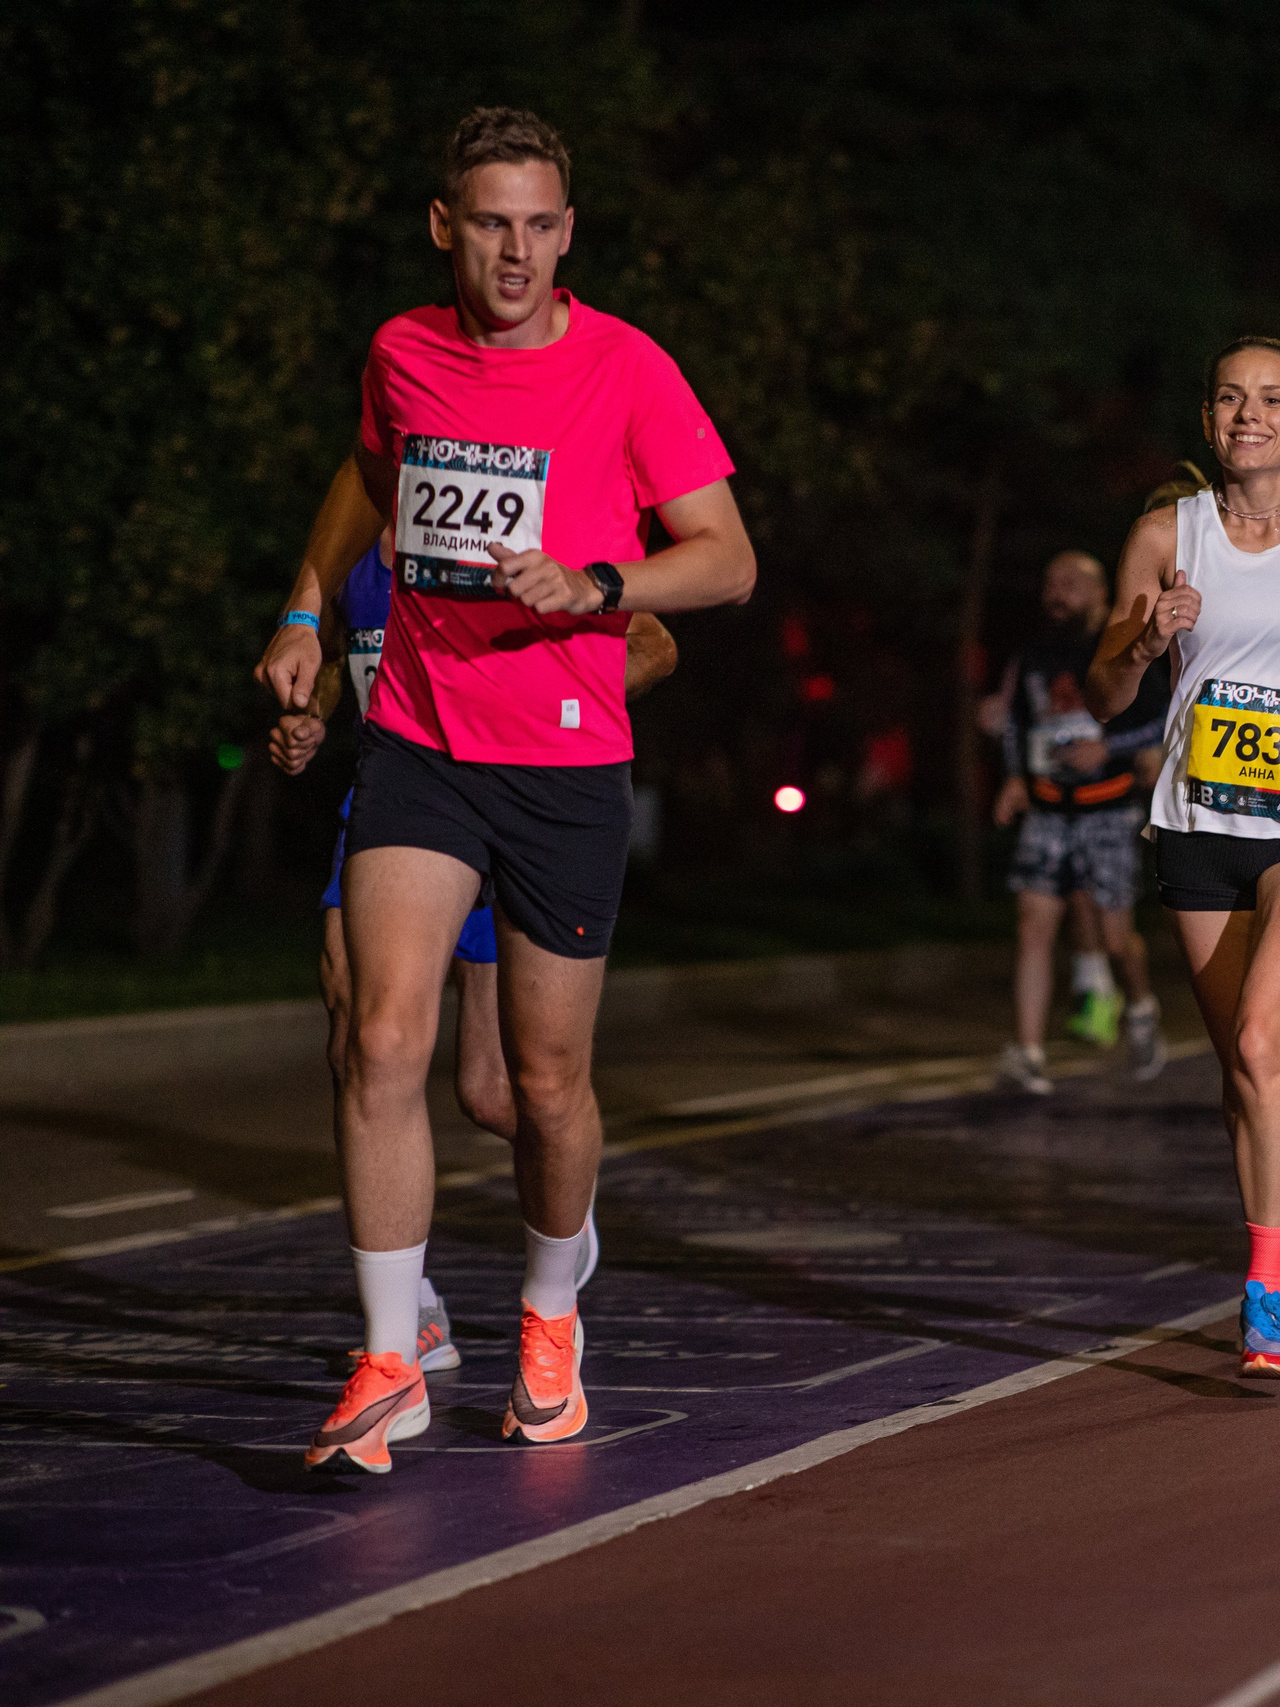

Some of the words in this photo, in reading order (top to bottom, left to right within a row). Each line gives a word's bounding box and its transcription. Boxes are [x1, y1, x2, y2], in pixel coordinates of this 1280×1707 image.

[412, 482, 525, 537] 2249
[423, 532, 503, 552] ВЛАДИМИ
[1238, 766, 1276, 781] АННА
